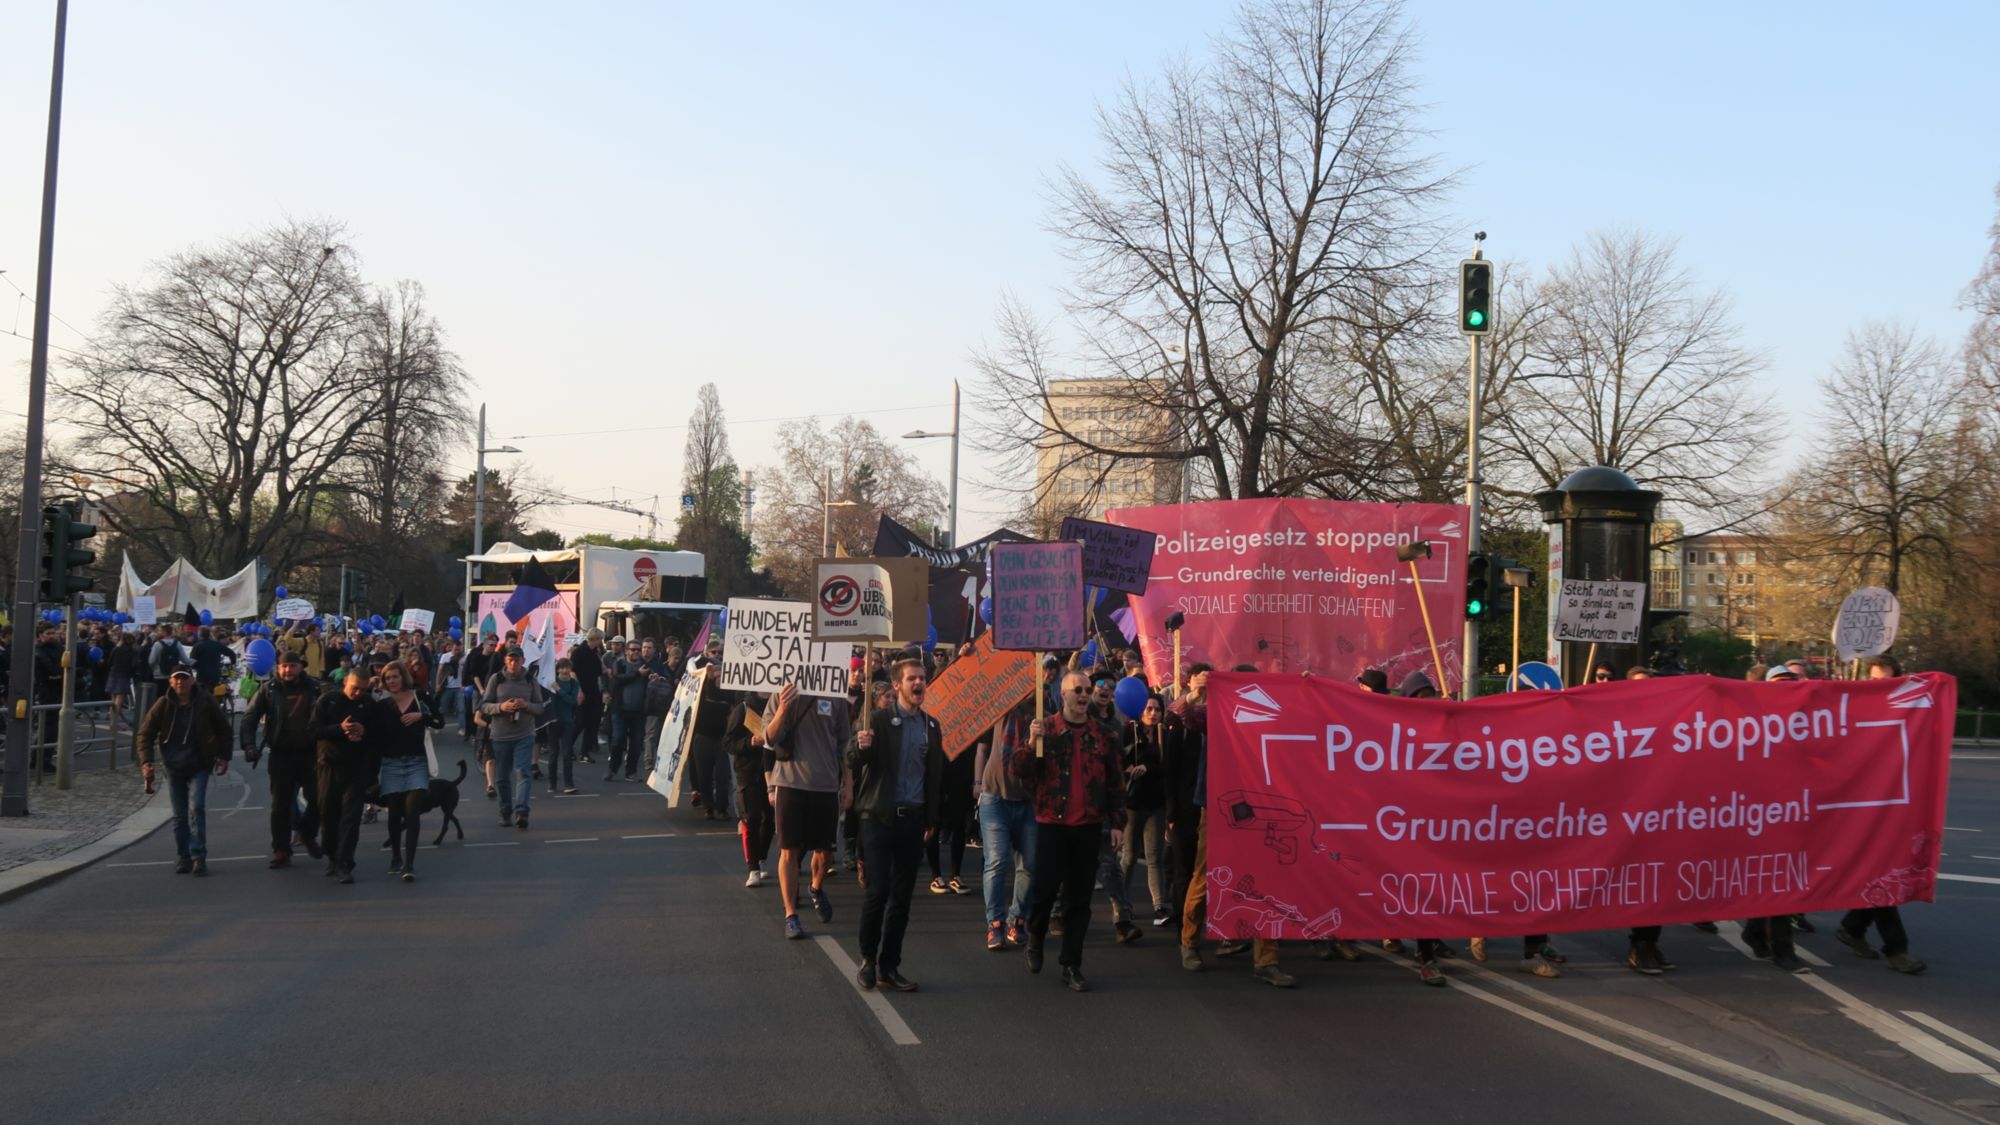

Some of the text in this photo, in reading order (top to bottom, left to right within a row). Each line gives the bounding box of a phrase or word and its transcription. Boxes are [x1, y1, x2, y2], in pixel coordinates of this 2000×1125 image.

[1155, 526, 1419, 555] Polizeigesetz stoppen!
[1177, 566, 1396, 589] Grundrechte verteidigen!
[1564, 583, 1594, 597] Steht
[1598, 584, 1619, 598] nicht
[1178, 594, 1395, 618] SOZIALE SICHERHEIT SCHAFFEN!
[1568, 599, 1578, 608] so
[1582, 598, 1613, 608] sinnlos
[1844, 592, 1893, 613] NEIN
[728, 609, 812, 632] HUNDEWE
[1033, 614, 1062, 628] DER
[1580, 610, 1617, 622] kippt die
[1003, 630, 1077, 646] POLIZEI
[1559, 623, 1618, 640] Bullenkarren
[722, 662, 849, 694] HANDGRANATEN
[1325, 693, 1849, 783] Polizeigesetz stoppen!
[1375, 788, 1811, 841] Grundrechte verteidigen!
[1380, 851, 1810, 915] SOZIALE SICHERHEIT SCHAFFEN!
